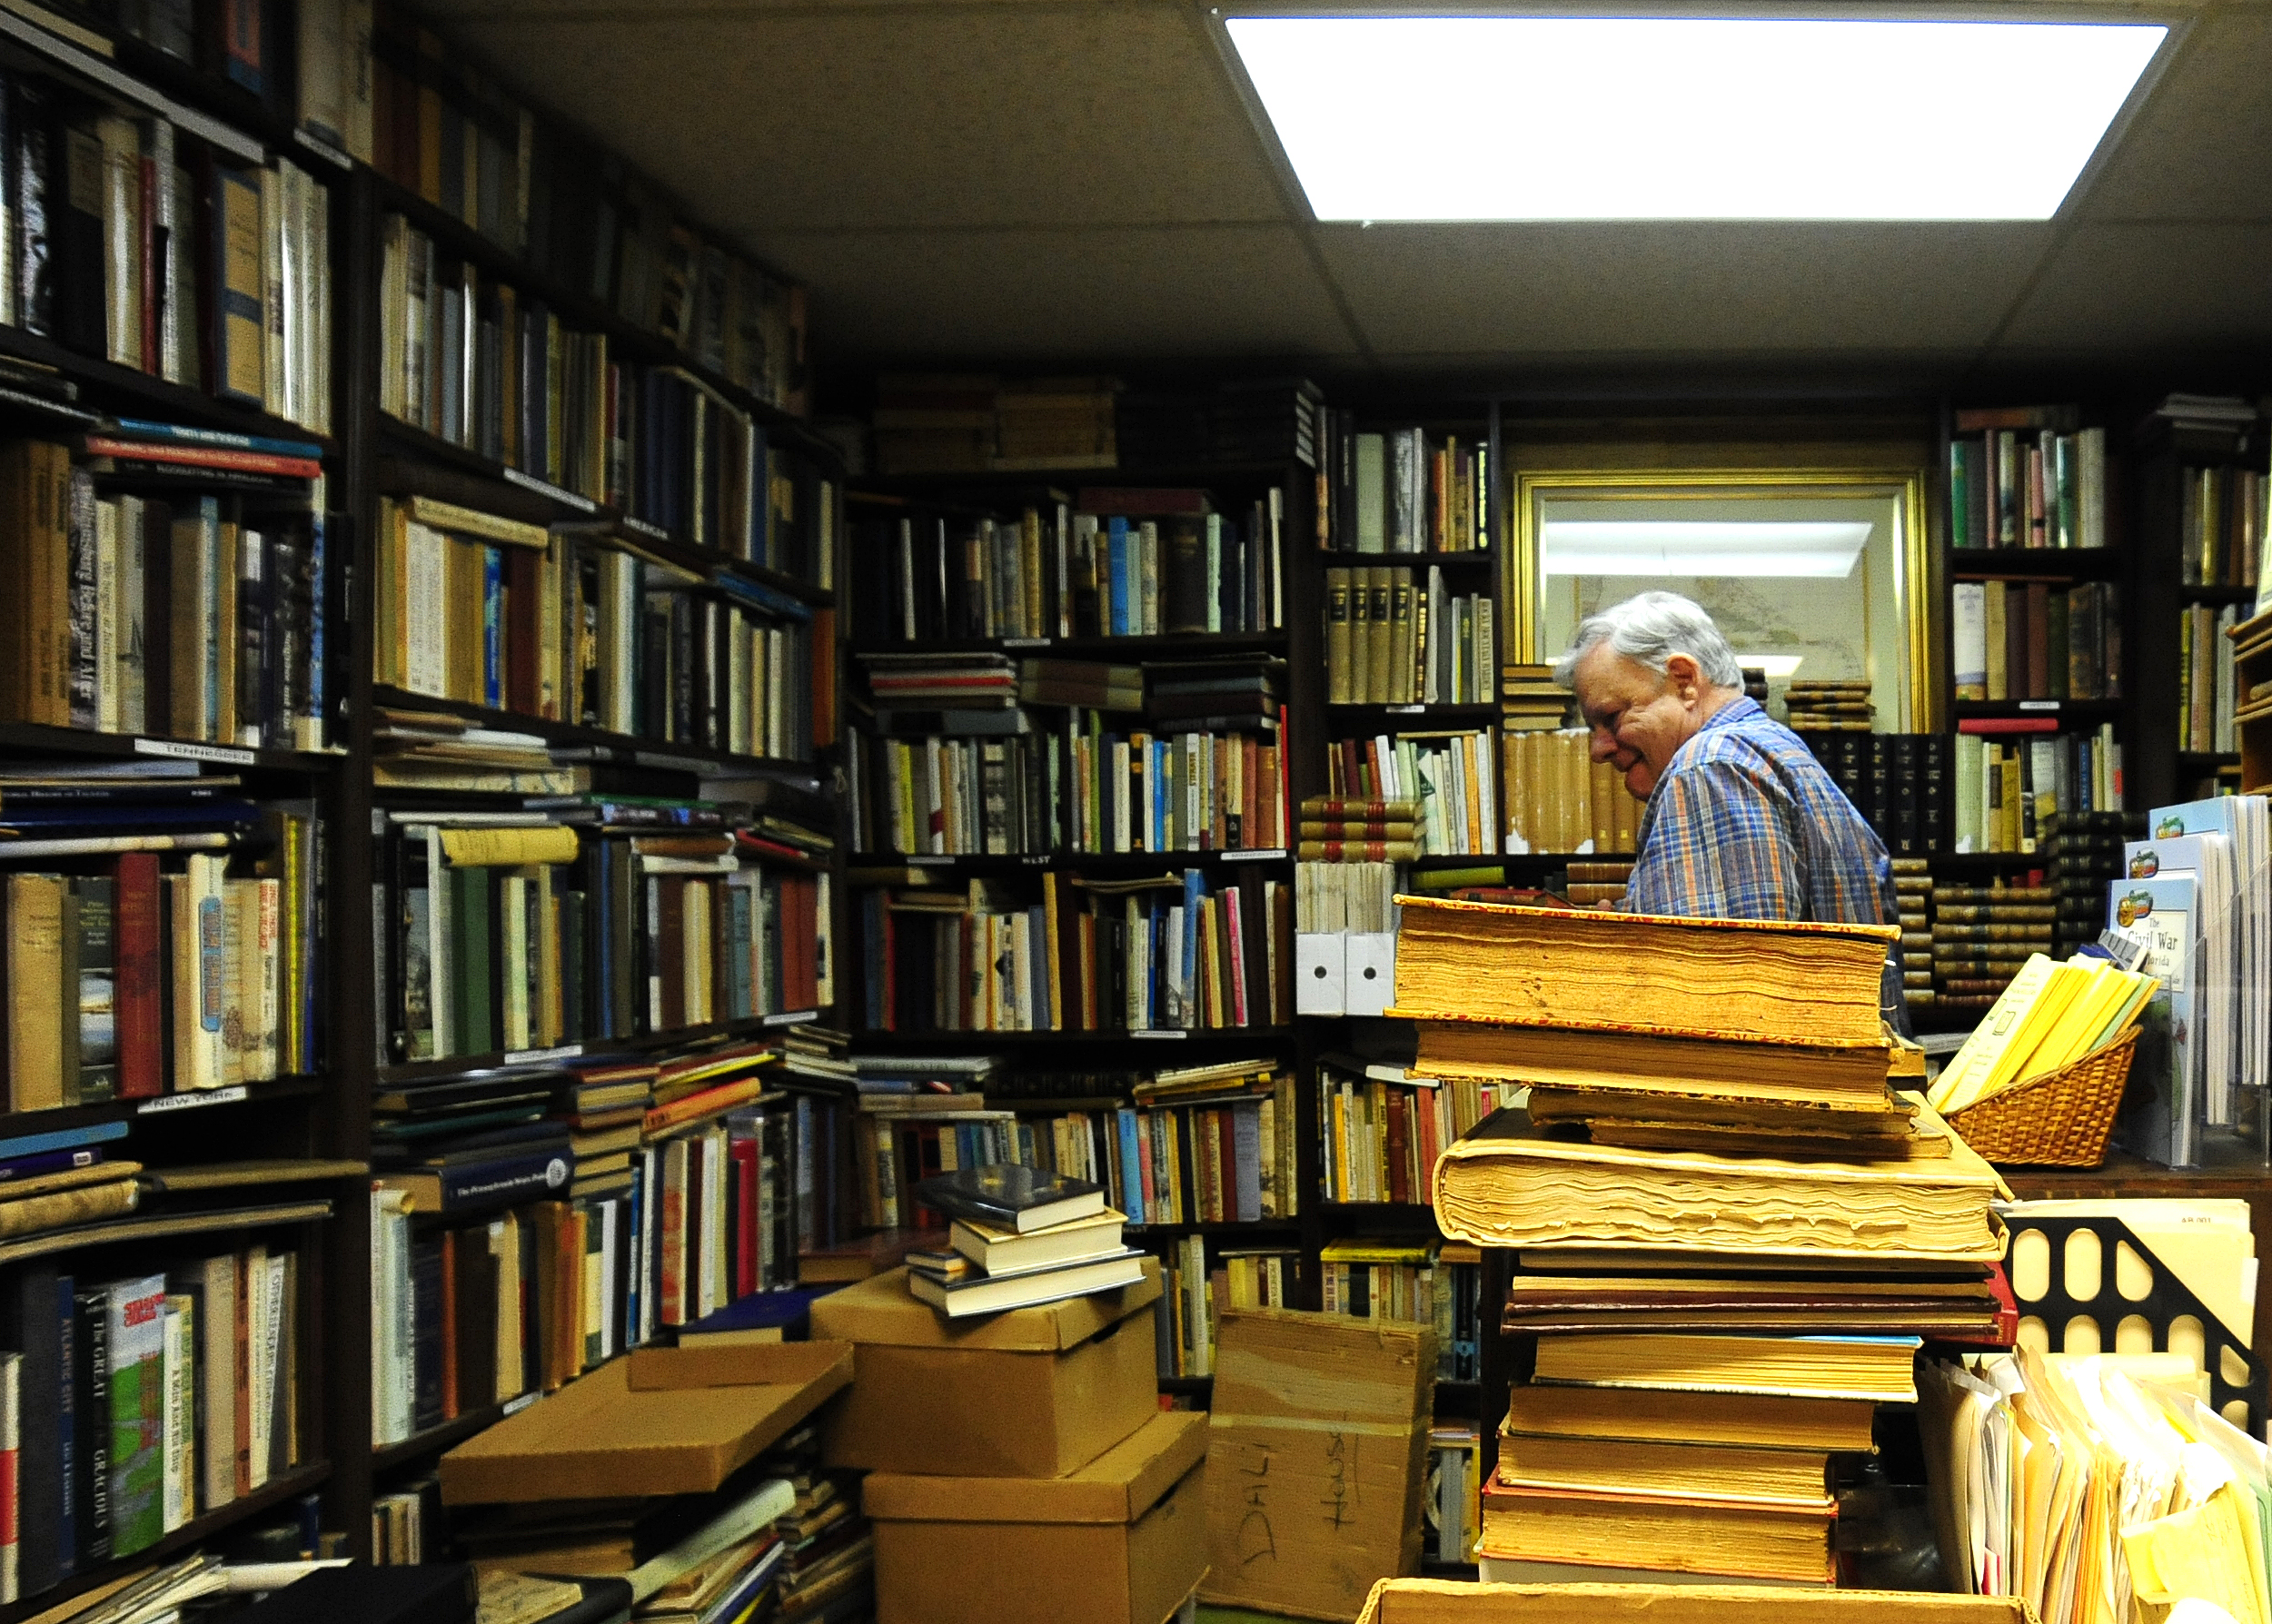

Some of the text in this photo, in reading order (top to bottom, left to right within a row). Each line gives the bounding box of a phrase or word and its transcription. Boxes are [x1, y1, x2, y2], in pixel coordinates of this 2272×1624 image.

[79, 585, 94, 630] Before
[79, 632, 94, 659] and
[78, 663, 94, 700] After
[166, 743, 252, 761] TENNESSEE
[2149, 917, 2160, 928] The
[2127, 931, 2178, 951] Civil War
[154, 1091, 234, 1108] NEW YORK
[92, 1321, 105, 1343] The
[60, 1318, 72, 1380] ATLANTIC
[92, 1346, 105, 1399] GREAT
[61, 1383, 72, 1414] CITY
[93, 1449, 106, 1530] GRACIOUS
